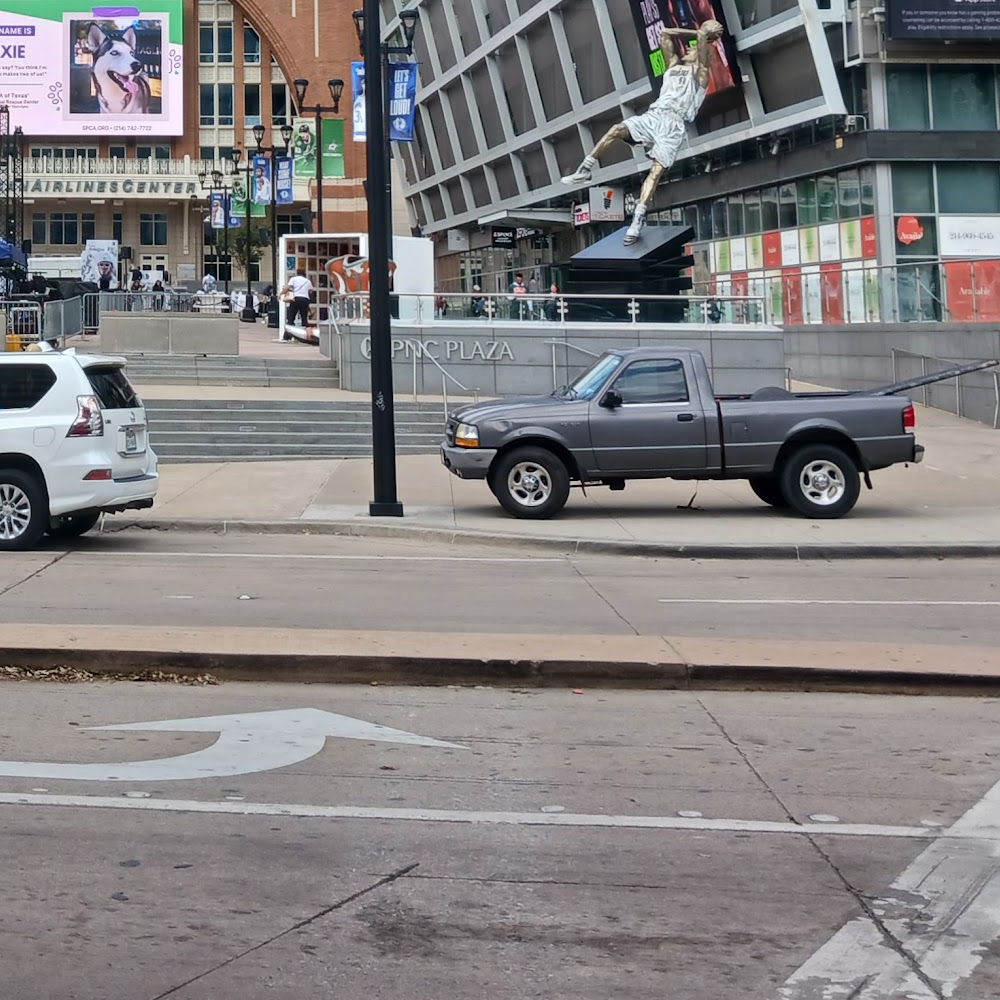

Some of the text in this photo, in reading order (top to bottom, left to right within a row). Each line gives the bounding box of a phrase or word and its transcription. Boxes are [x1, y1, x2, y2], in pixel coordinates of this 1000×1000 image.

[24, 27, 32, 35] IS
[394, 70, 409, 83] LET'S
[394, 83, 408, 98] GET
[390, 99, 411, 116] LOUD!
[391, 339, 515, 361] PNC PLAZA
